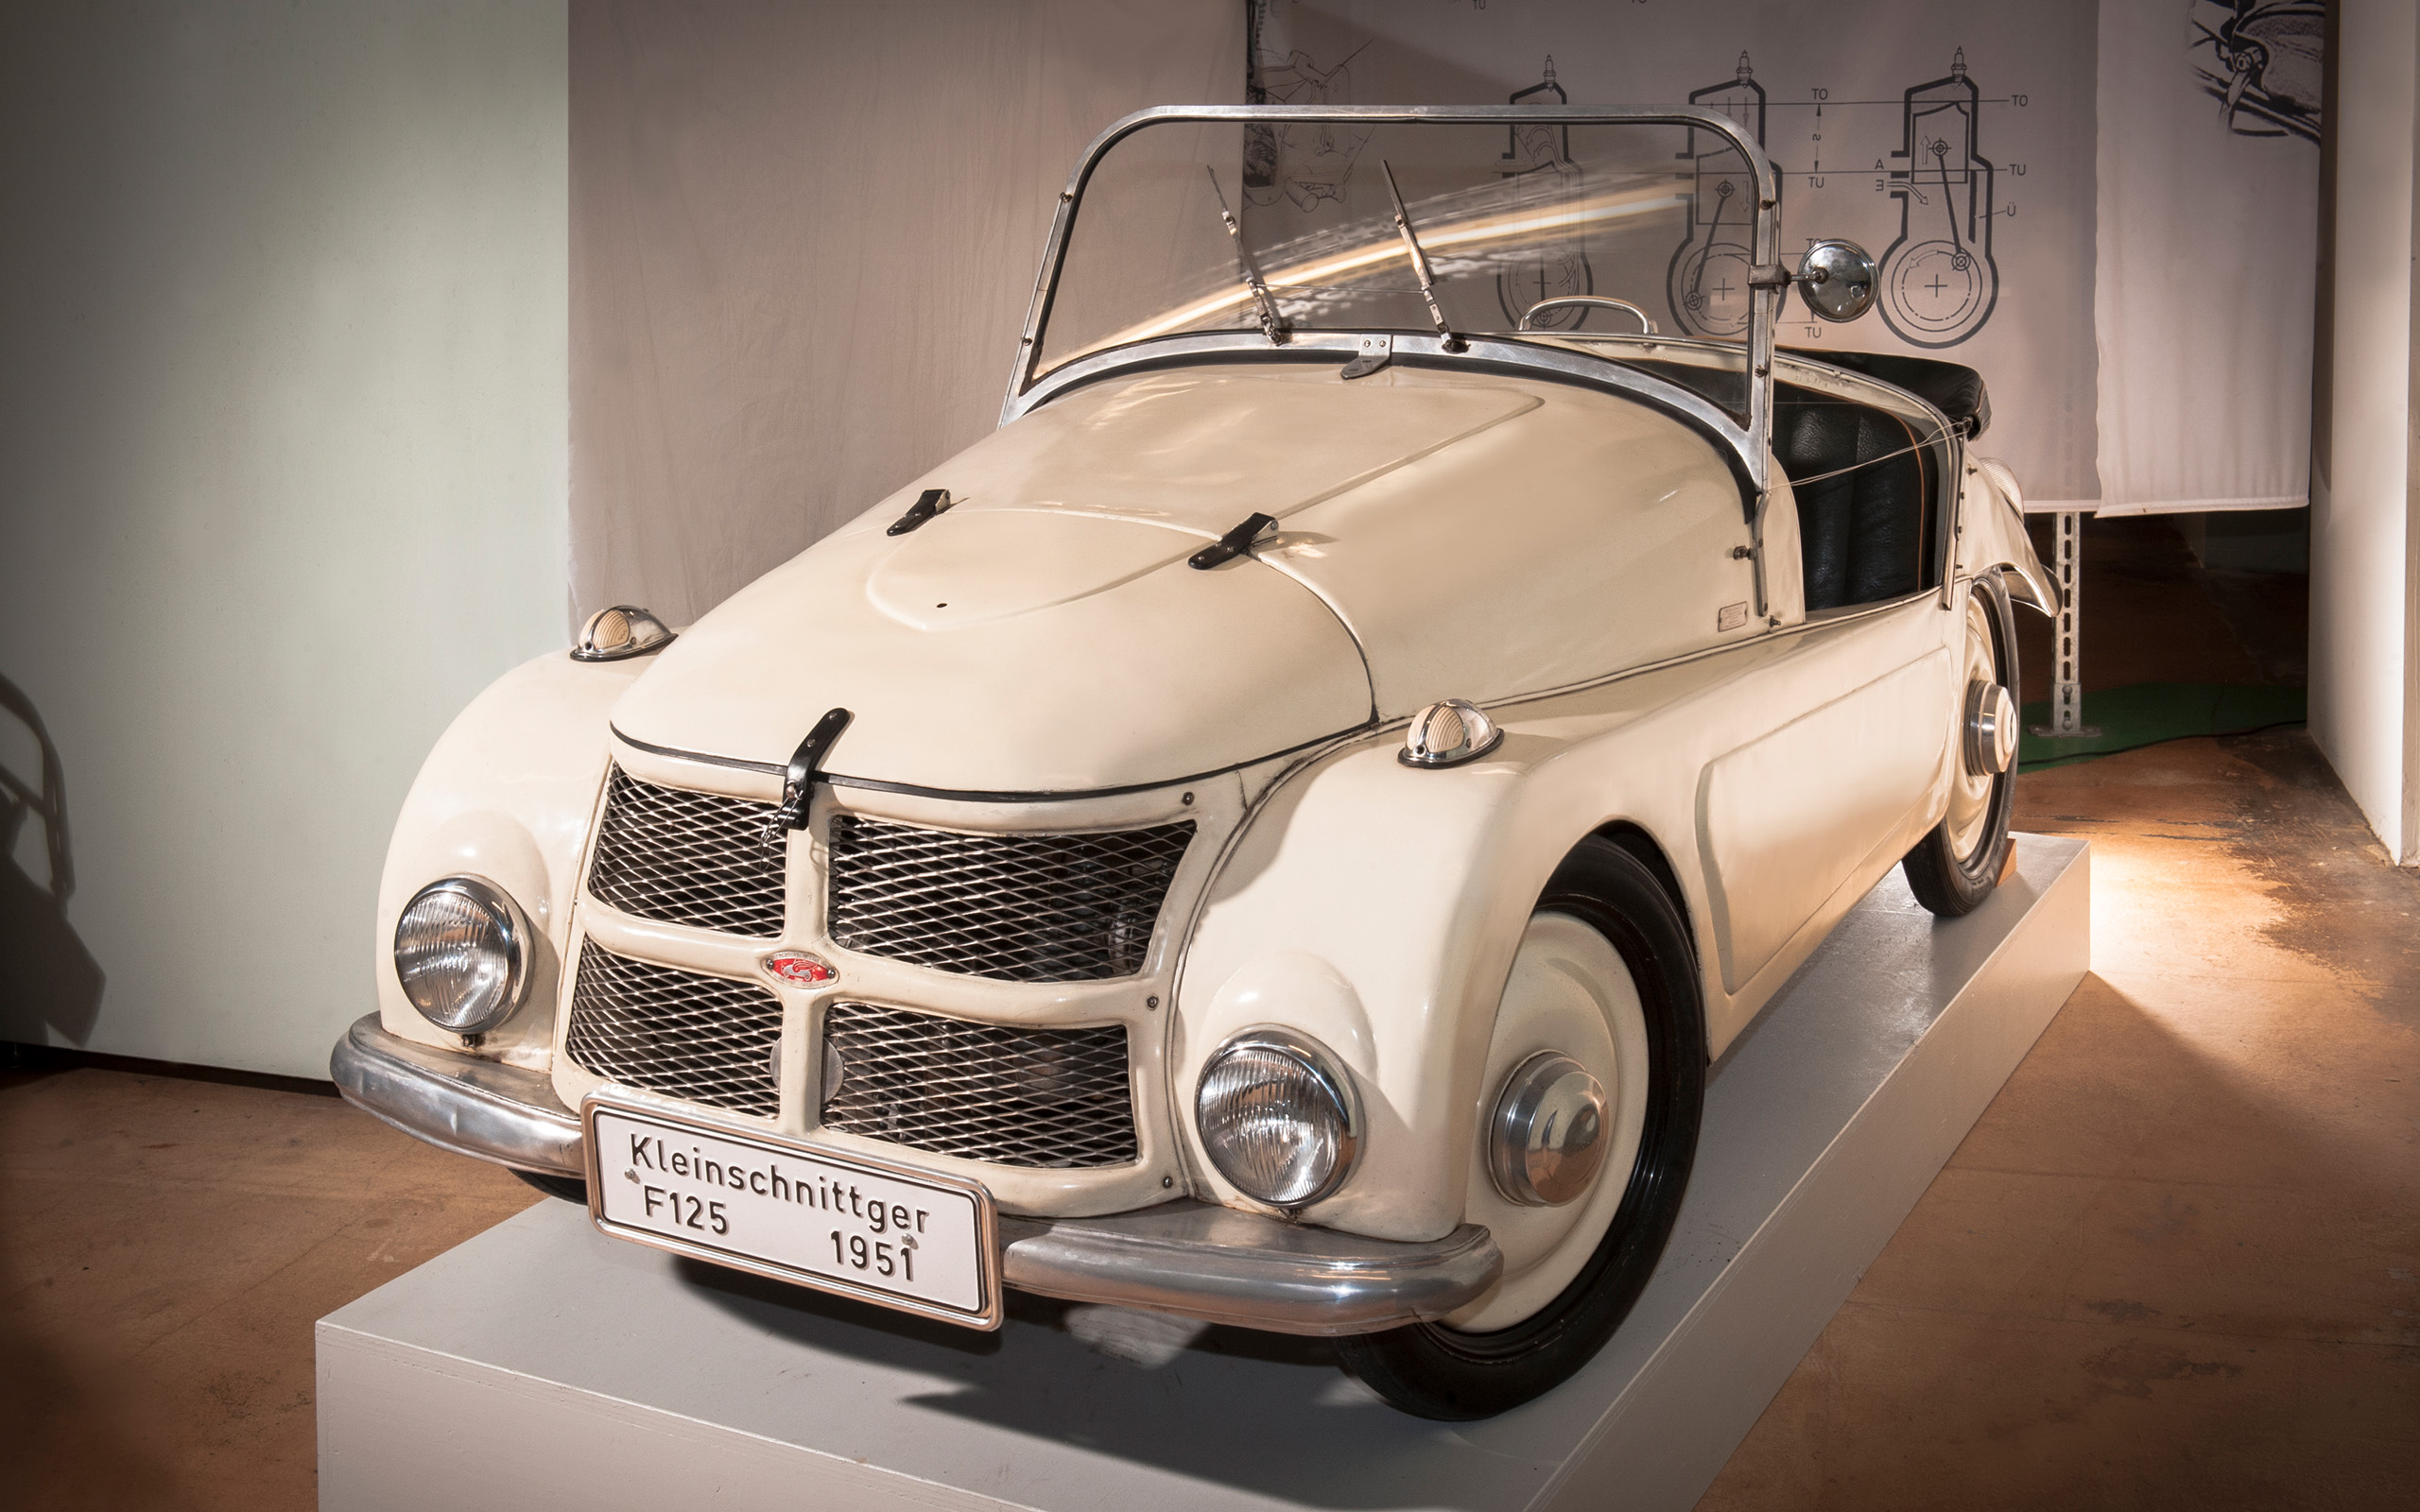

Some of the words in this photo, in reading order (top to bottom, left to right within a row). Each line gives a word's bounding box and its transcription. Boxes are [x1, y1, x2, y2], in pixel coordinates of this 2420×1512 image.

[630, 1132, 929, 1235] Kleinschnittger
[644, 1186, 729, 1235] F125
[830, 1229, 914, 1281] 1951
